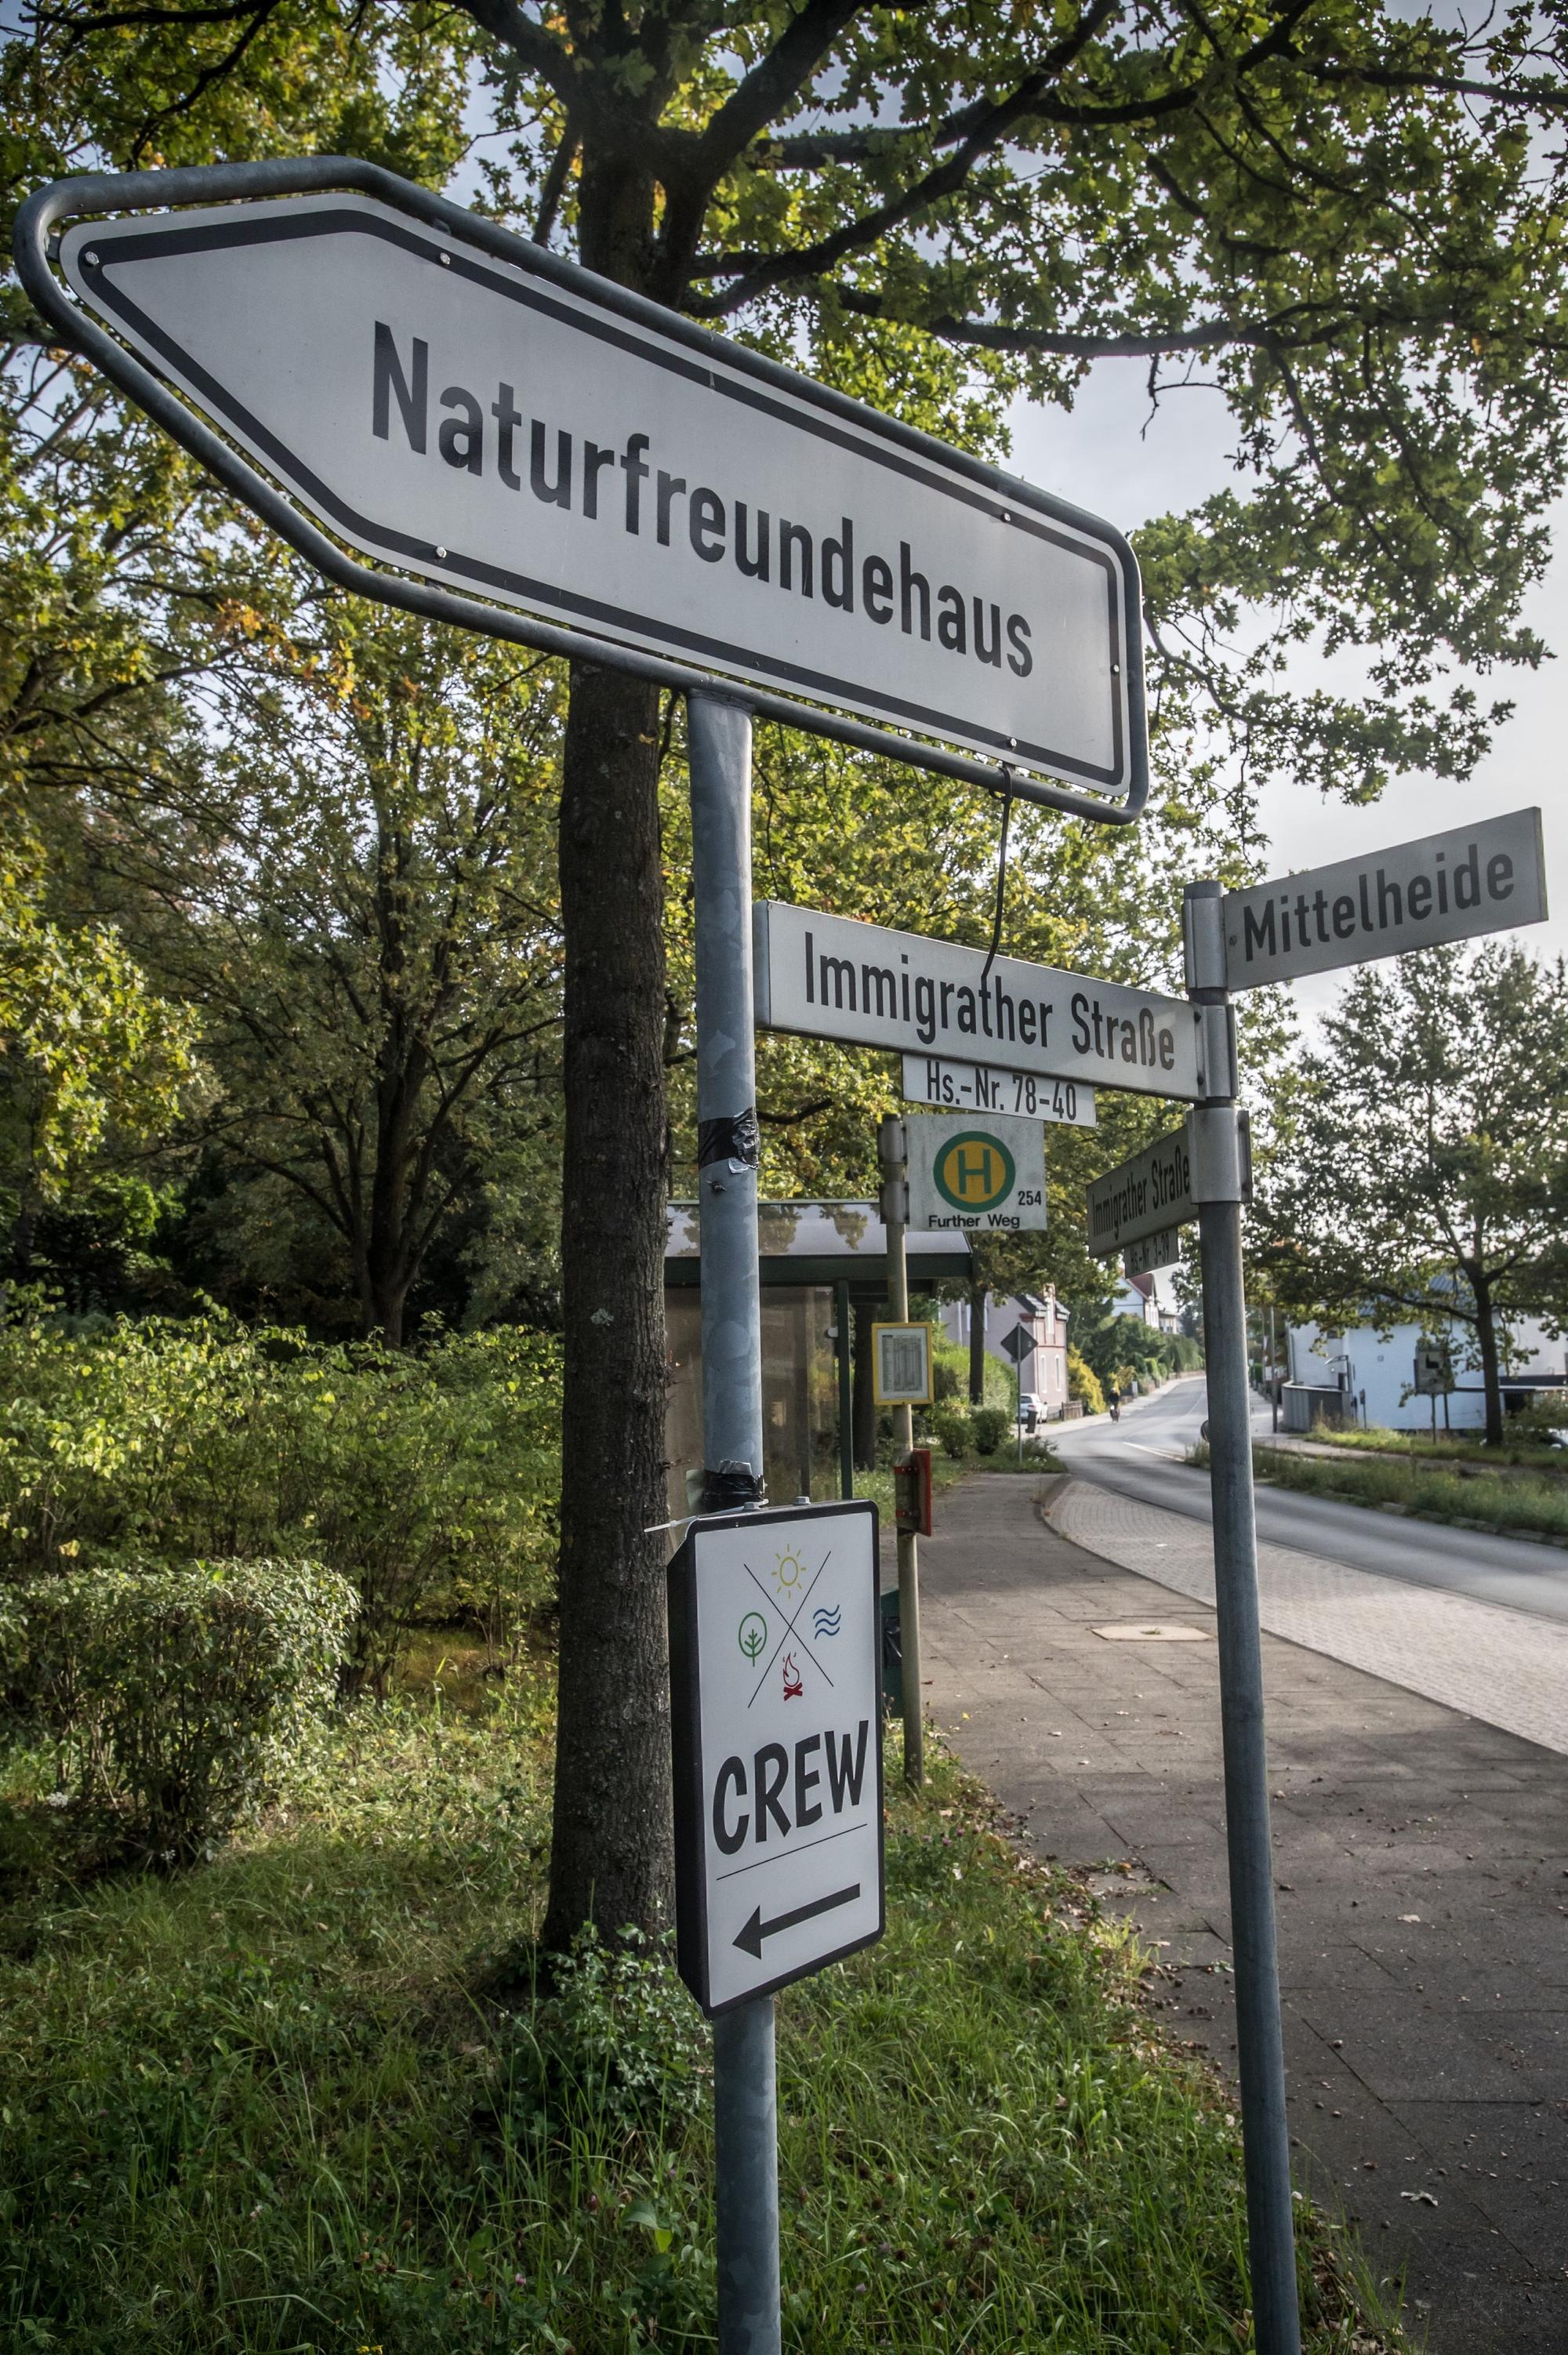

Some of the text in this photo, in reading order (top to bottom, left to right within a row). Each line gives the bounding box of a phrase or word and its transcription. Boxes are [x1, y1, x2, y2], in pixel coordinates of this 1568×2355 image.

[372, 320, 1033, 678] Naturfreundehaus
[1243, 844, 1515, 962] Mittelheide
[804, 931, 1175, 1071] Immigrather Straße
[927, 1060, 1076, 1120] Hs.-Nr. 78-40
[957, 1149, 992, 1194] H
[1018, 1190, 1042, 1206] 254
[1092, 1145, 1190, 1241] Immigrather Straße
[928, 1214, 1020, 1228] Further Weg
[712, 1720, 869, 1856] CREW
